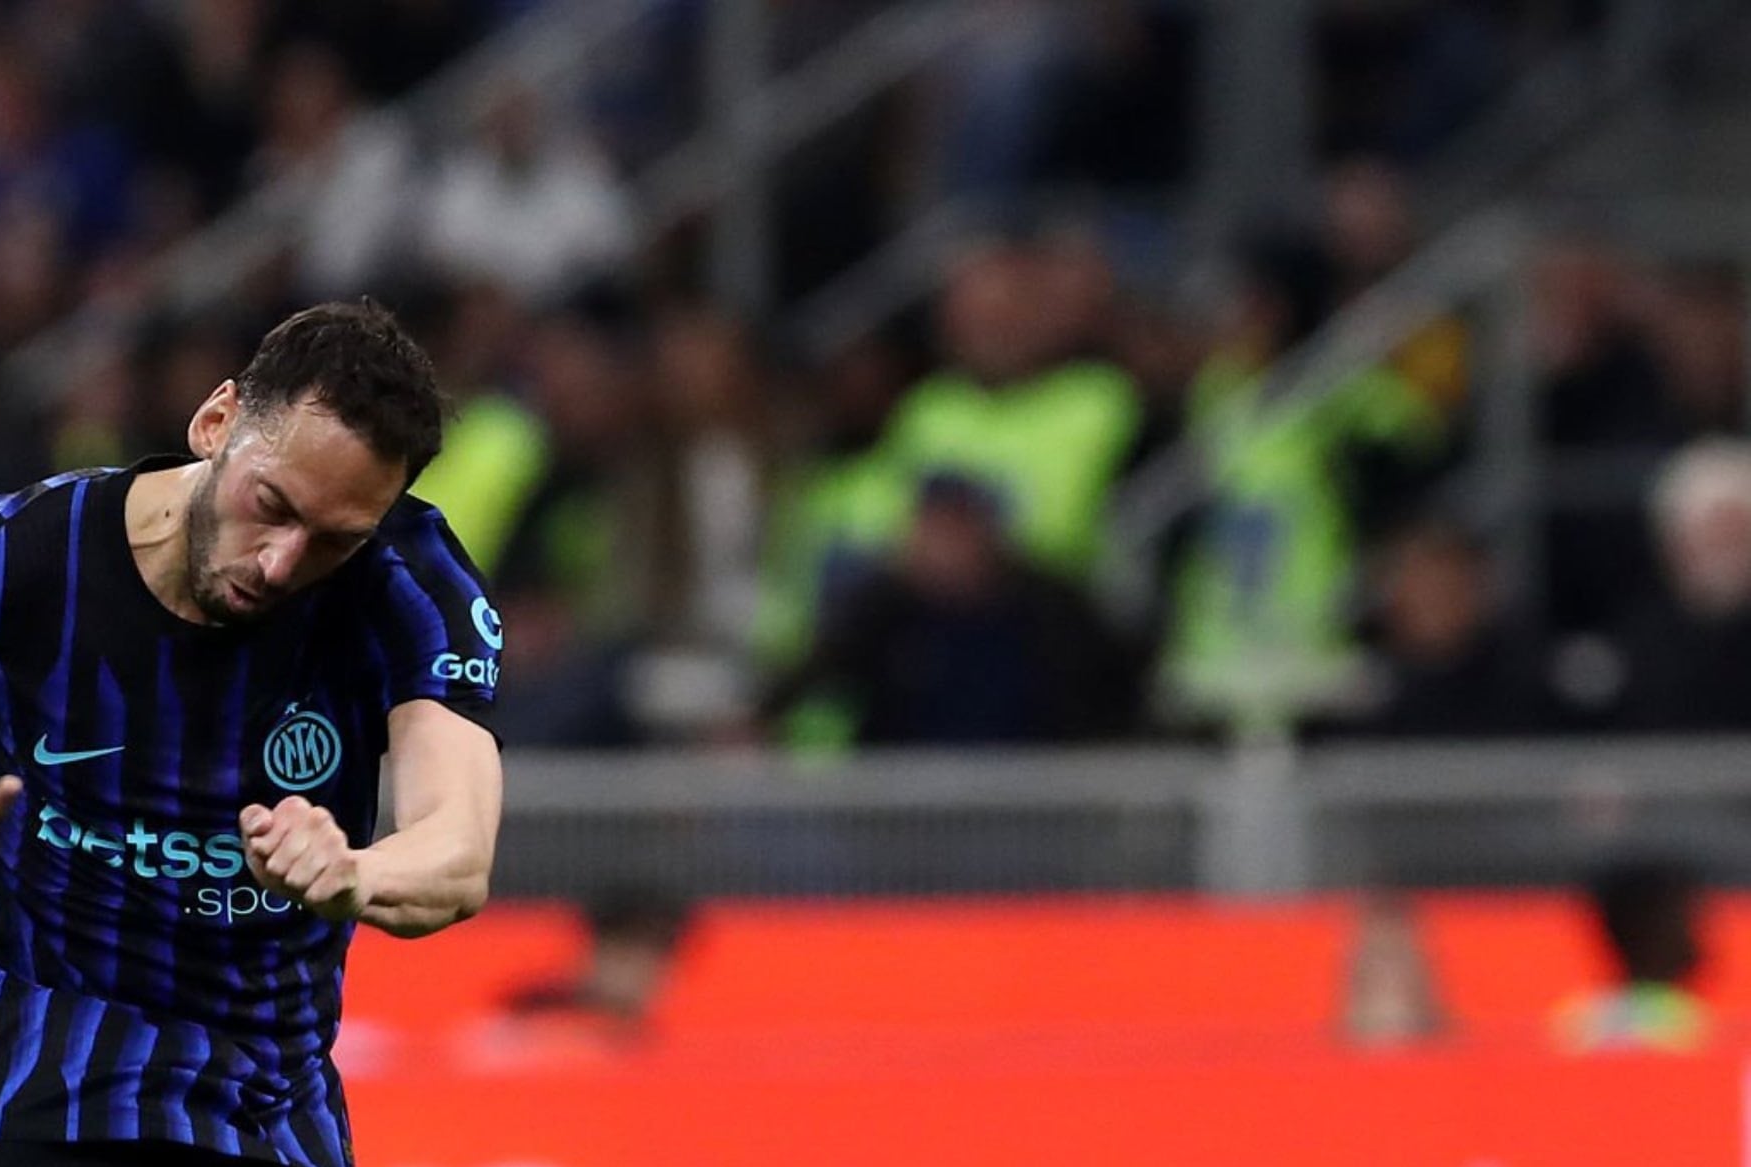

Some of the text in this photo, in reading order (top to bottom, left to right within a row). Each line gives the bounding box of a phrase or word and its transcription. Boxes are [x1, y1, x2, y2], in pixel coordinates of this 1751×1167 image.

[431, 652, 501, 688] Gat
[37, 803, 245, 879] betss
[184, 886, 303, 924] .spo
